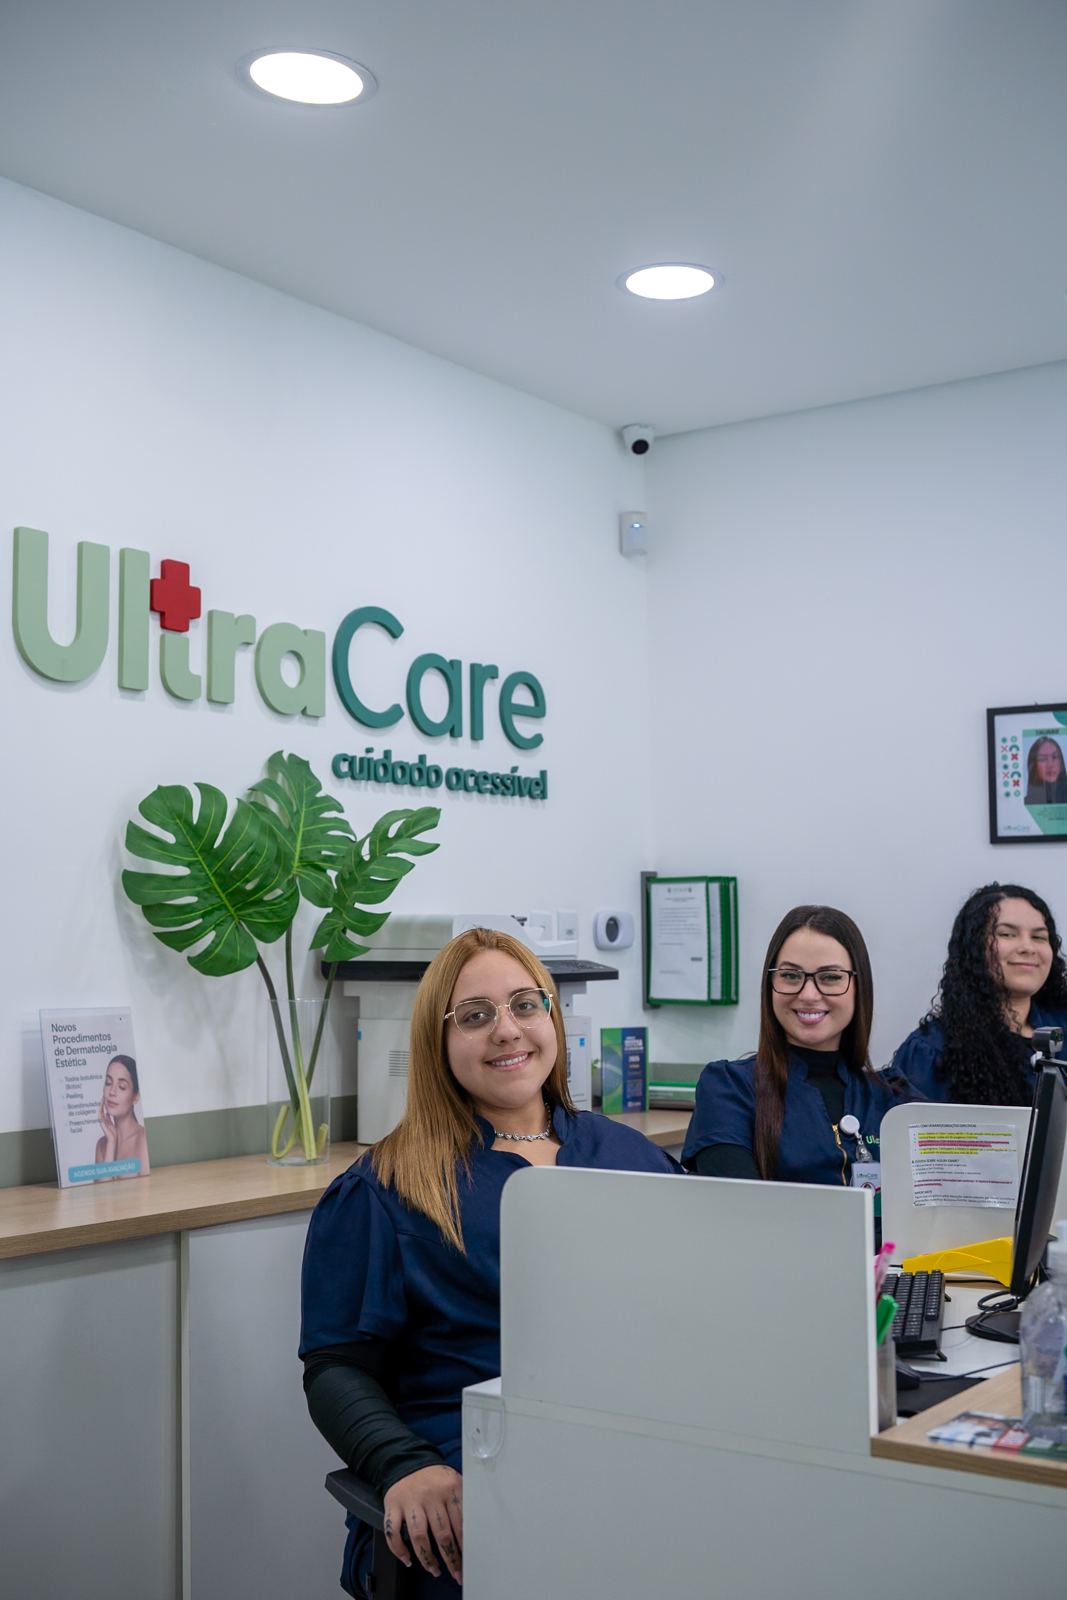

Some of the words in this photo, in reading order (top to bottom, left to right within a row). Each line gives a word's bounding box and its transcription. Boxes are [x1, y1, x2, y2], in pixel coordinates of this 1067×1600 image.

[332, 747, 443, 788] cuidado
[445, 766, 548, 800] acessível
[51, 1023, 78, 1032] Novos
[52, 1033, 112, 1044] Procedimentos
[54, 1046, 65, 1056] de
[66, 1043, 118, 1055] Dermatologia
[55, 1058, 87, 1068] Estética
